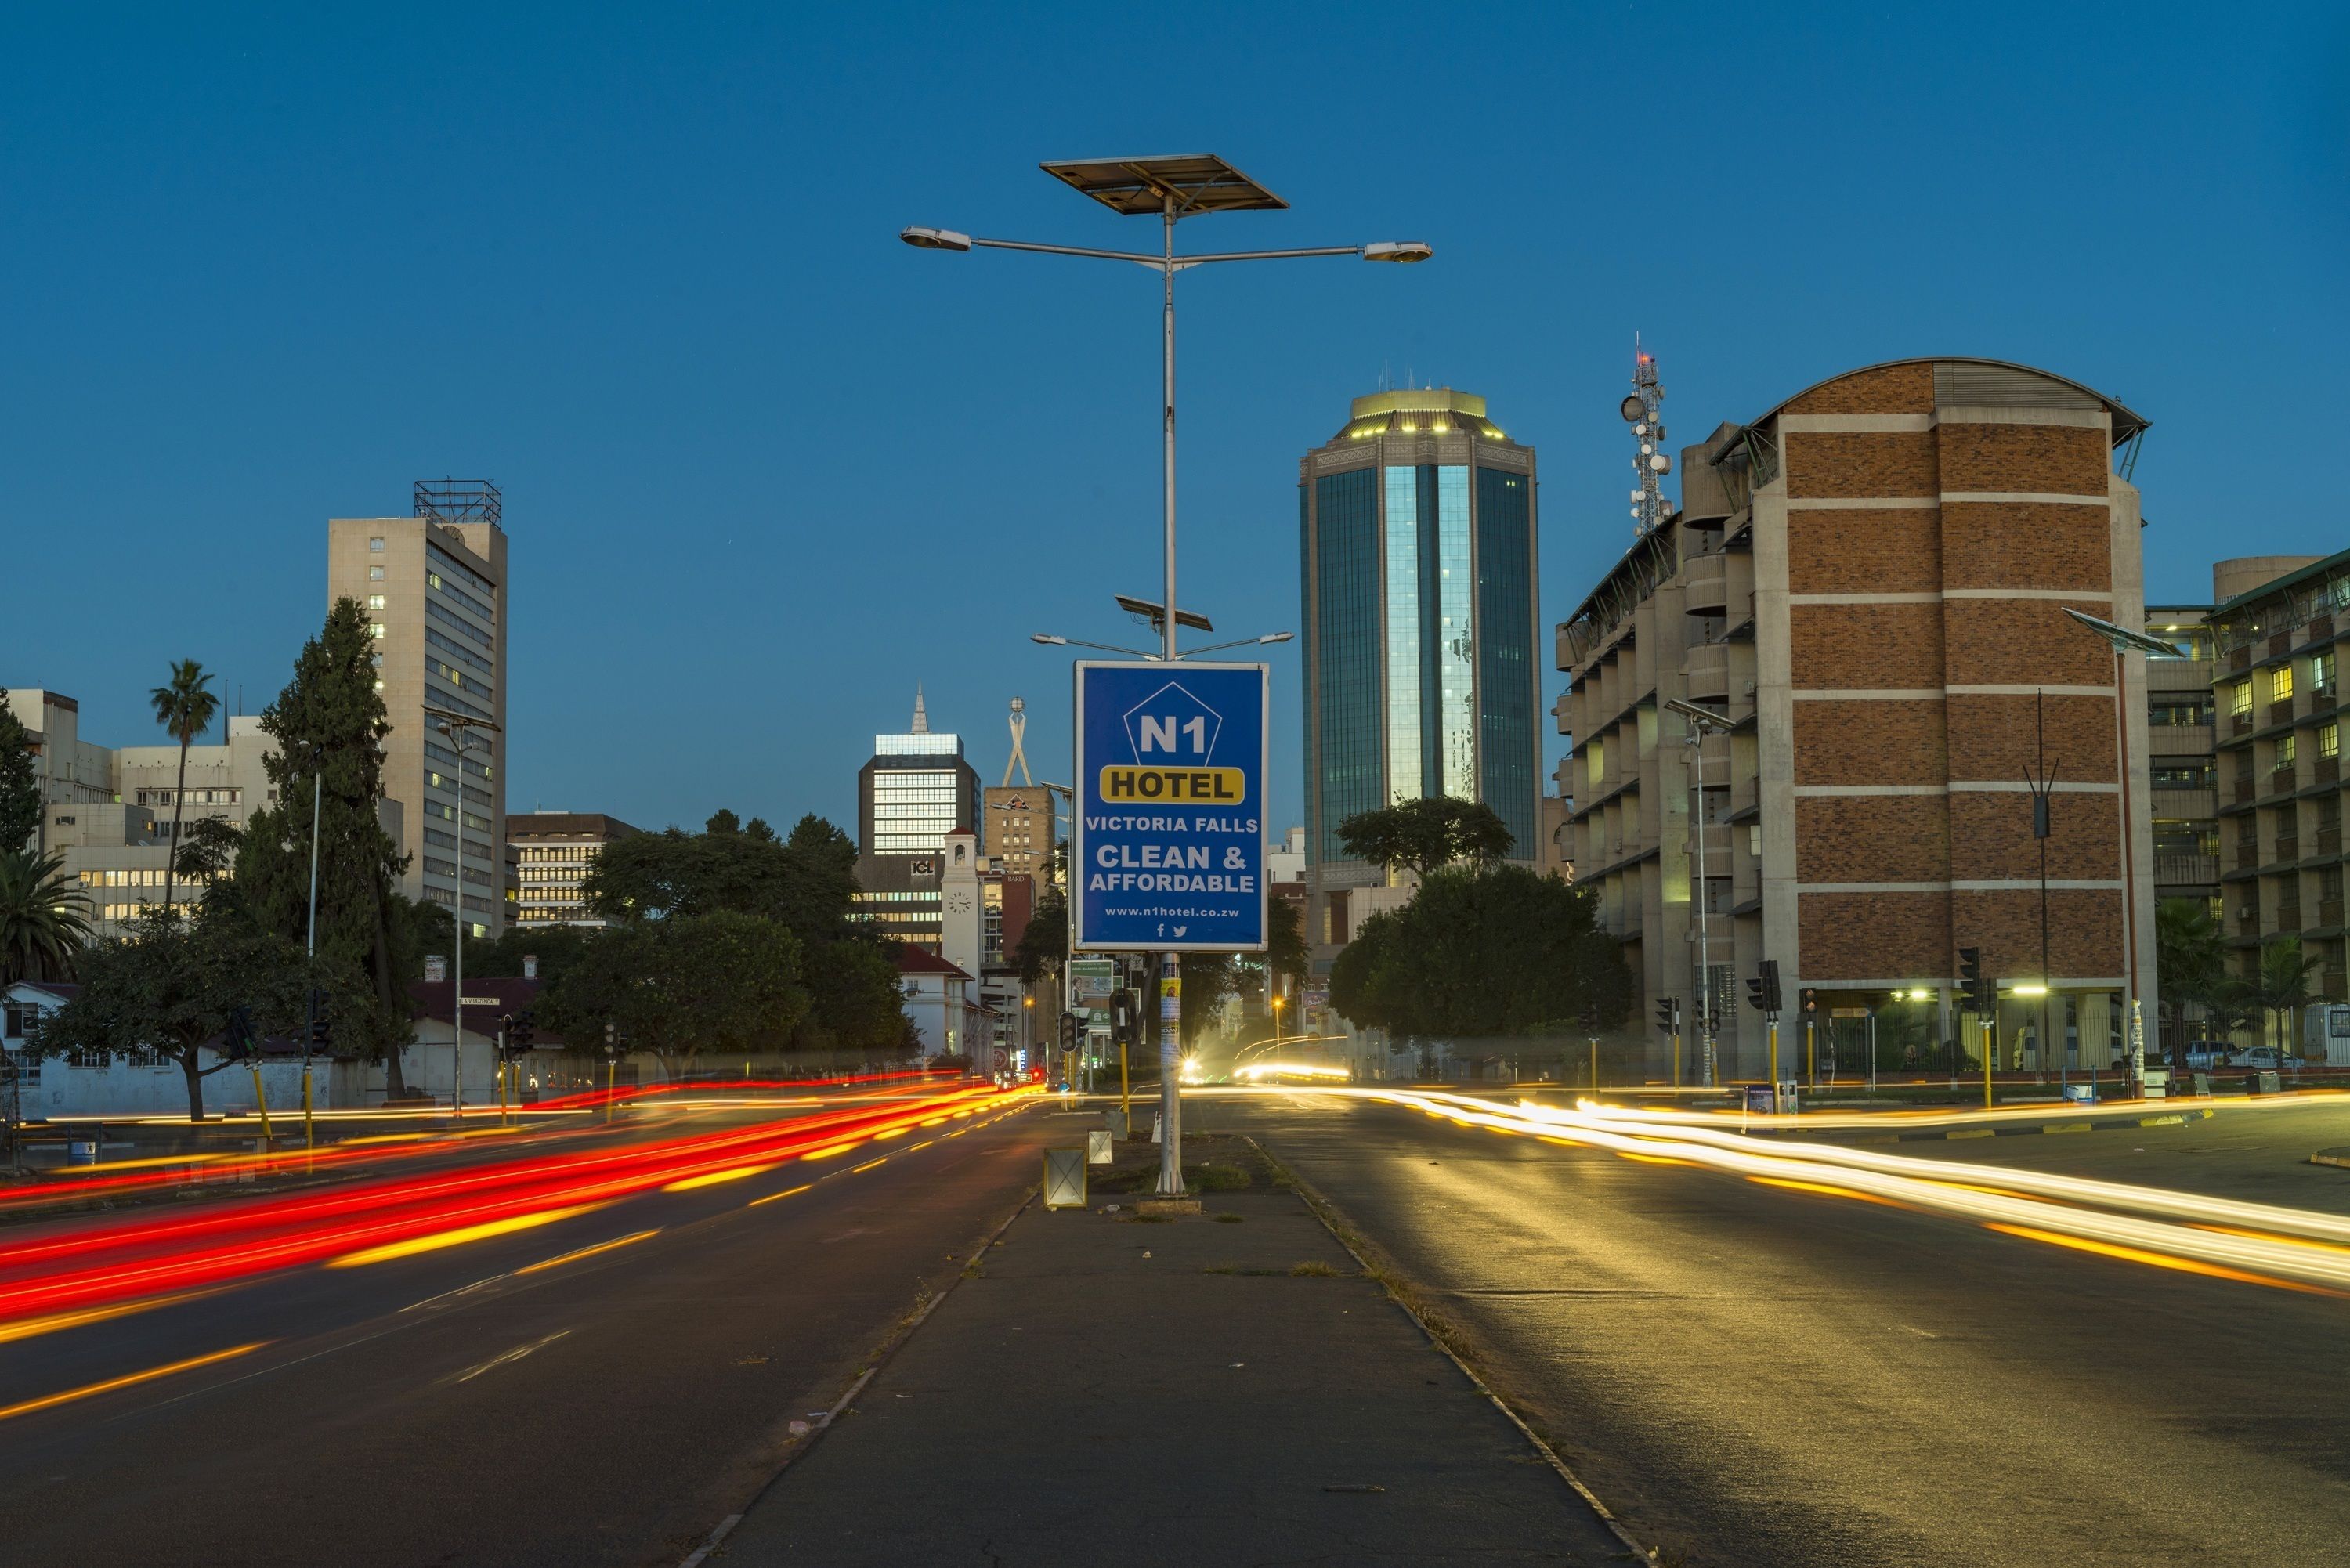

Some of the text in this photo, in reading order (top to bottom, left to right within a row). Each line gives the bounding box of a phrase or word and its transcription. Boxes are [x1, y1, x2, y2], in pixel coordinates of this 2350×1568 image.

[1141, 716, 1205, 753] N1
[1111, 771, 1234, 799] HOTEL
[1086, 817, 1258, 833] VICTORIA FALLS
[1097, 844, 1247, 870] CLEAN &
[913, 862, 934, 874] ICL
[1089, 873, 1254, 893] AFFORDABLE
[1105, 906, 1239, 917] www.n1hotel.co.zw
